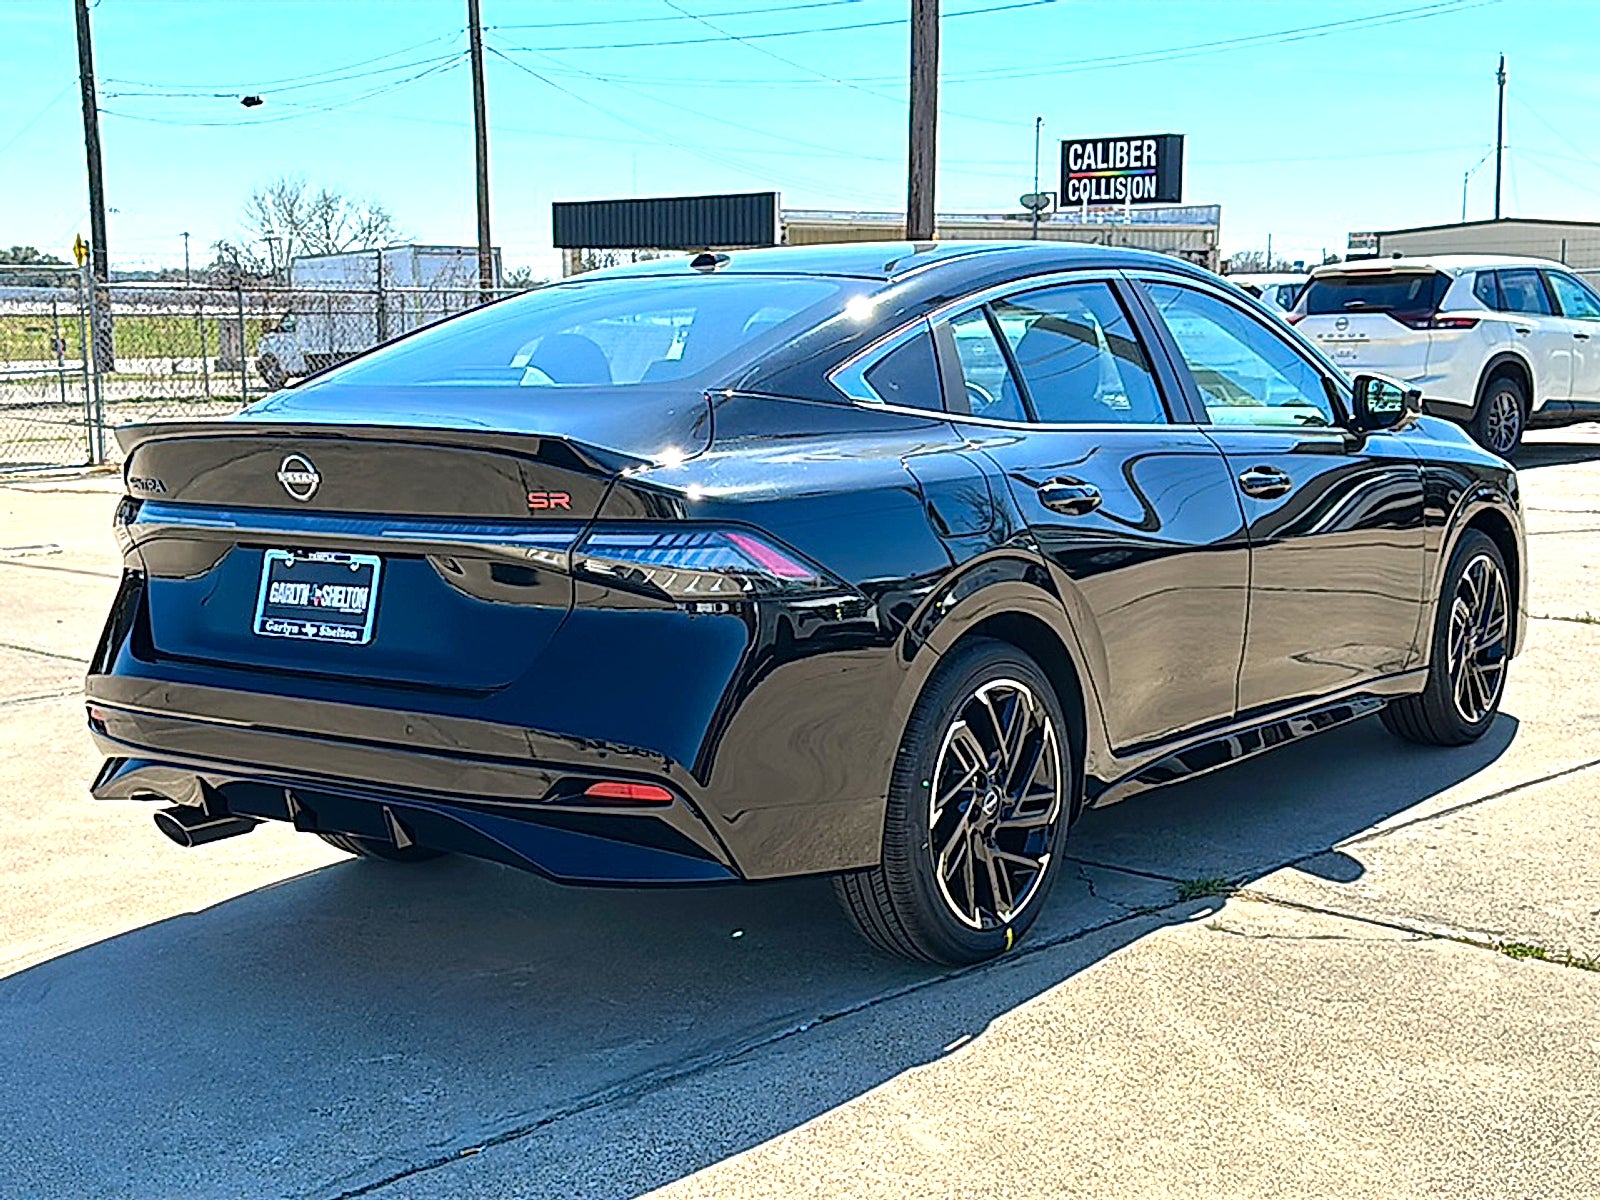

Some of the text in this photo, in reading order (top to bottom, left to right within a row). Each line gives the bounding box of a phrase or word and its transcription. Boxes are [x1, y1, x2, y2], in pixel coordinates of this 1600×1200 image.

[1068, 139, 1157, 170] CALIBER
[1067, 175, 1157, 201] COLLISION
[528, 492, 571, 510] SR
[320, 584, 369, 609] SHELTON
